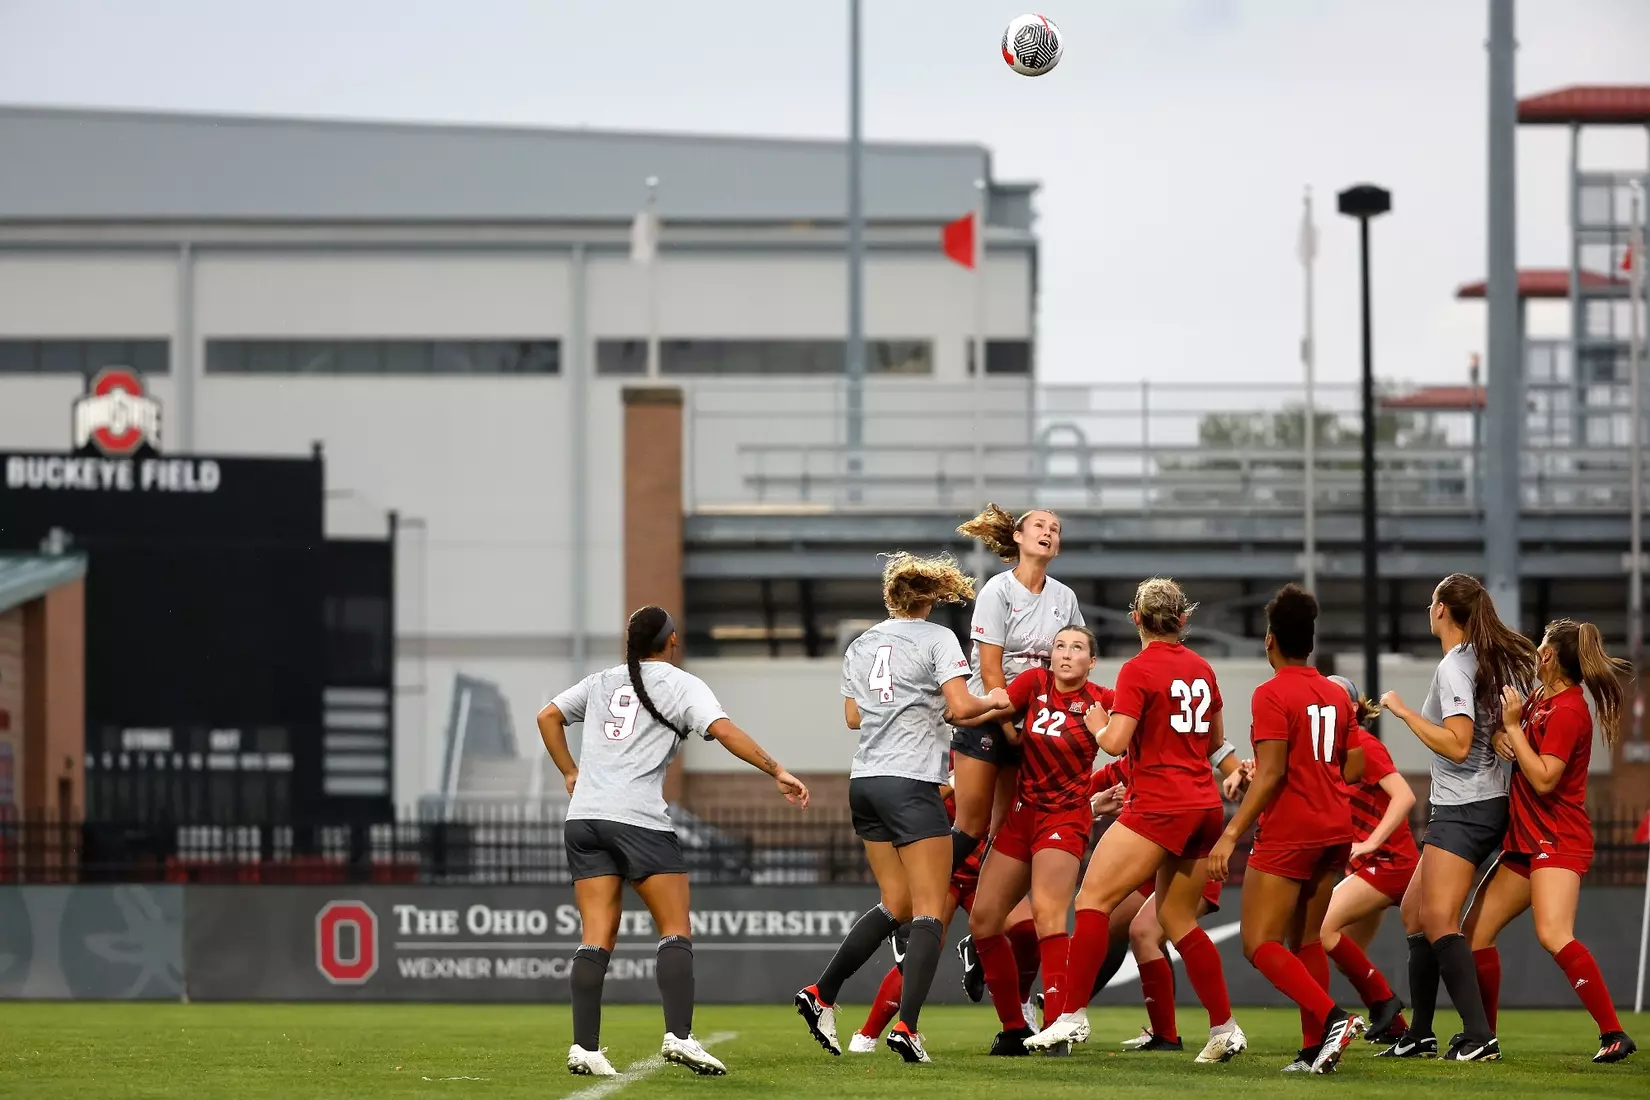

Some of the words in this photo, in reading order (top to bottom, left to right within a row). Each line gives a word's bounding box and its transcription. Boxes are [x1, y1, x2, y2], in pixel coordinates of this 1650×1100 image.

[6, 456, 134, 490] BUCKEYE
[142, 458, 220, 492] FIELD
[869, 645, 894, 703] 4
[604, 684, 641, 740] 9
[1031, 707, 1067, 737] 22
[1170, 678, 1211, 733] 32
[1307, 704, 1337, 763] 11
[690, 909, 857, 936] NIVERSITY
[397, 957, 492, 979] WEXNER
